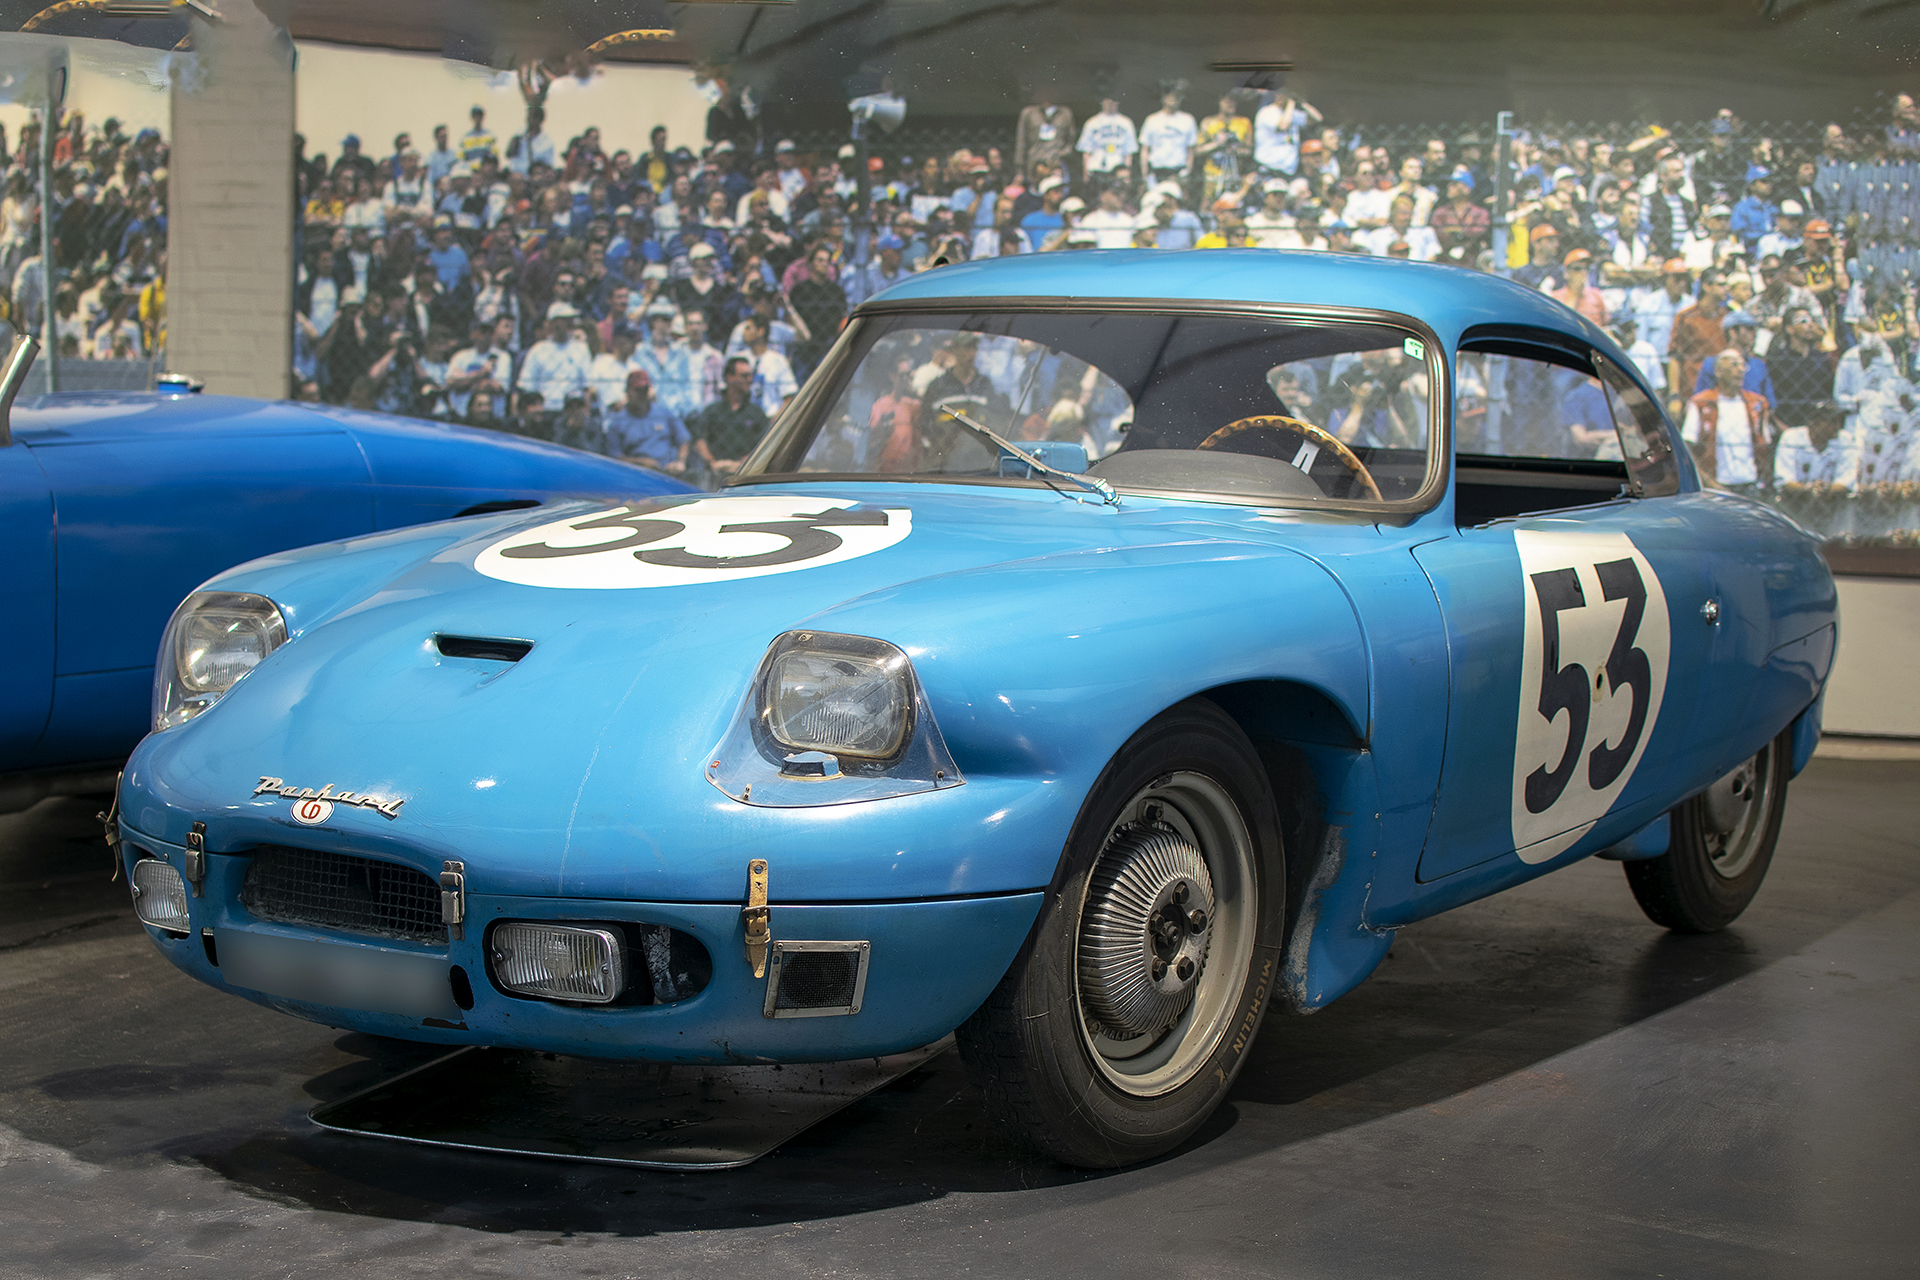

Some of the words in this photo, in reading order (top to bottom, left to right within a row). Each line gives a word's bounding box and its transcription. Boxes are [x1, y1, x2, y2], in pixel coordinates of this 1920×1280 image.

[1524, 557, 1652, 815] 53
[252, 775, 406, 820] Panhard
[1232, 958, 1273, 1055] MICHELIN
